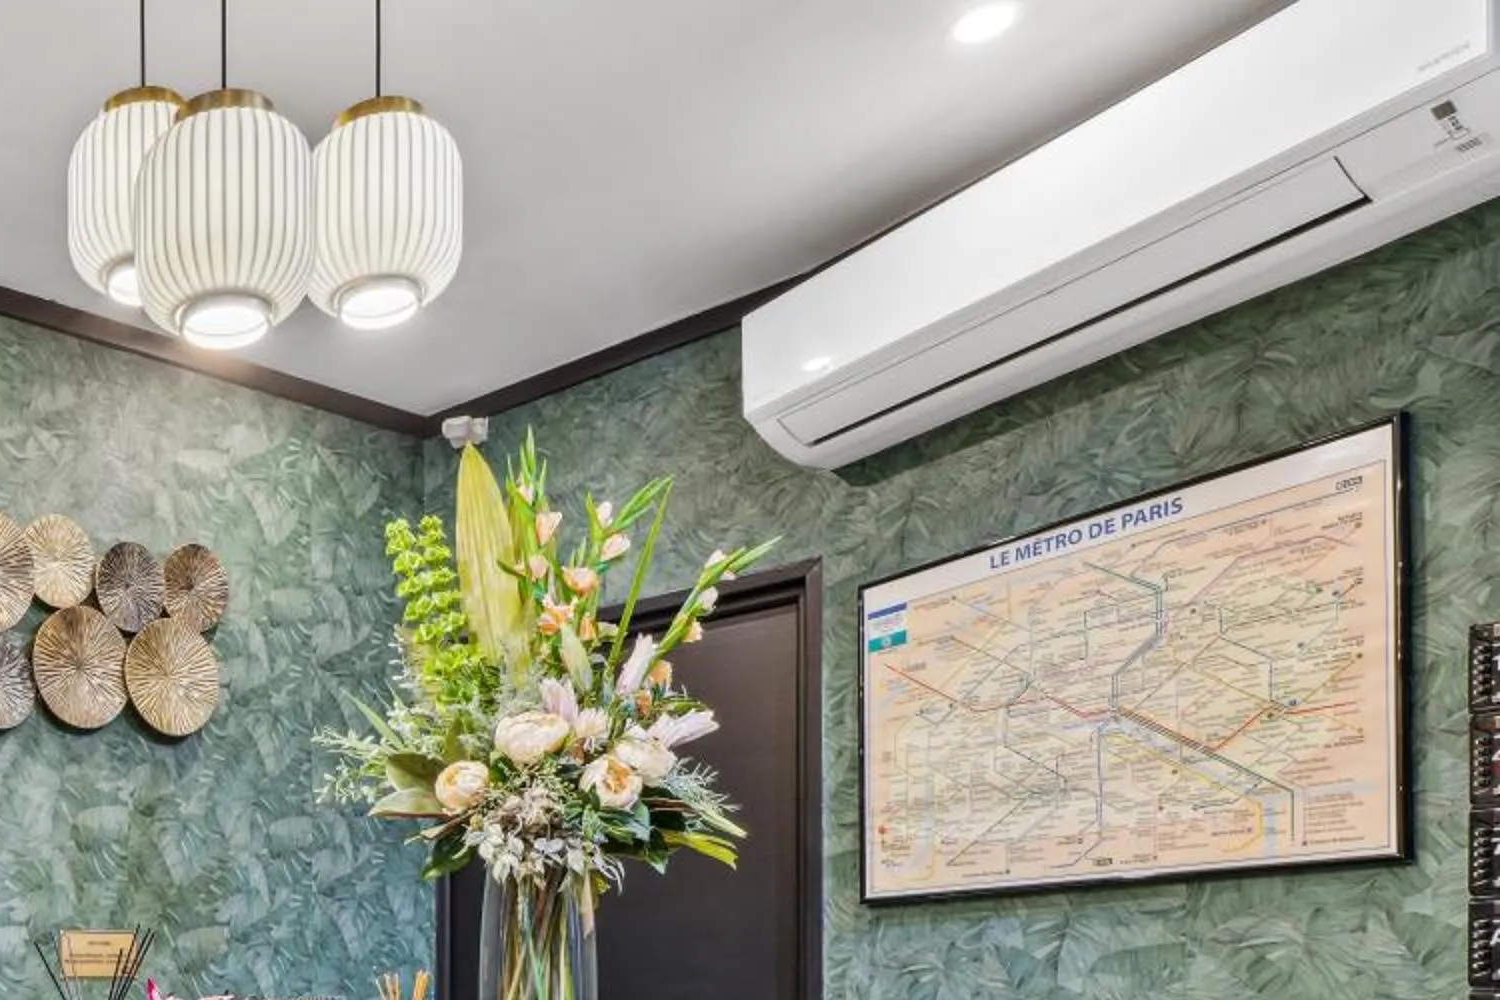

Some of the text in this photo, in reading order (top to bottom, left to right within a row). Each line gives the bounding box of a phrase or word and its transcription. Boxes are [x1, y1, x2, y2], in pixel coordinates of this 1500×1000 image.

[990, 549, 1011, 569] LE
[1088, 517, 1117, 540] DE
[1122, 497, 1184, 530] PARIS
